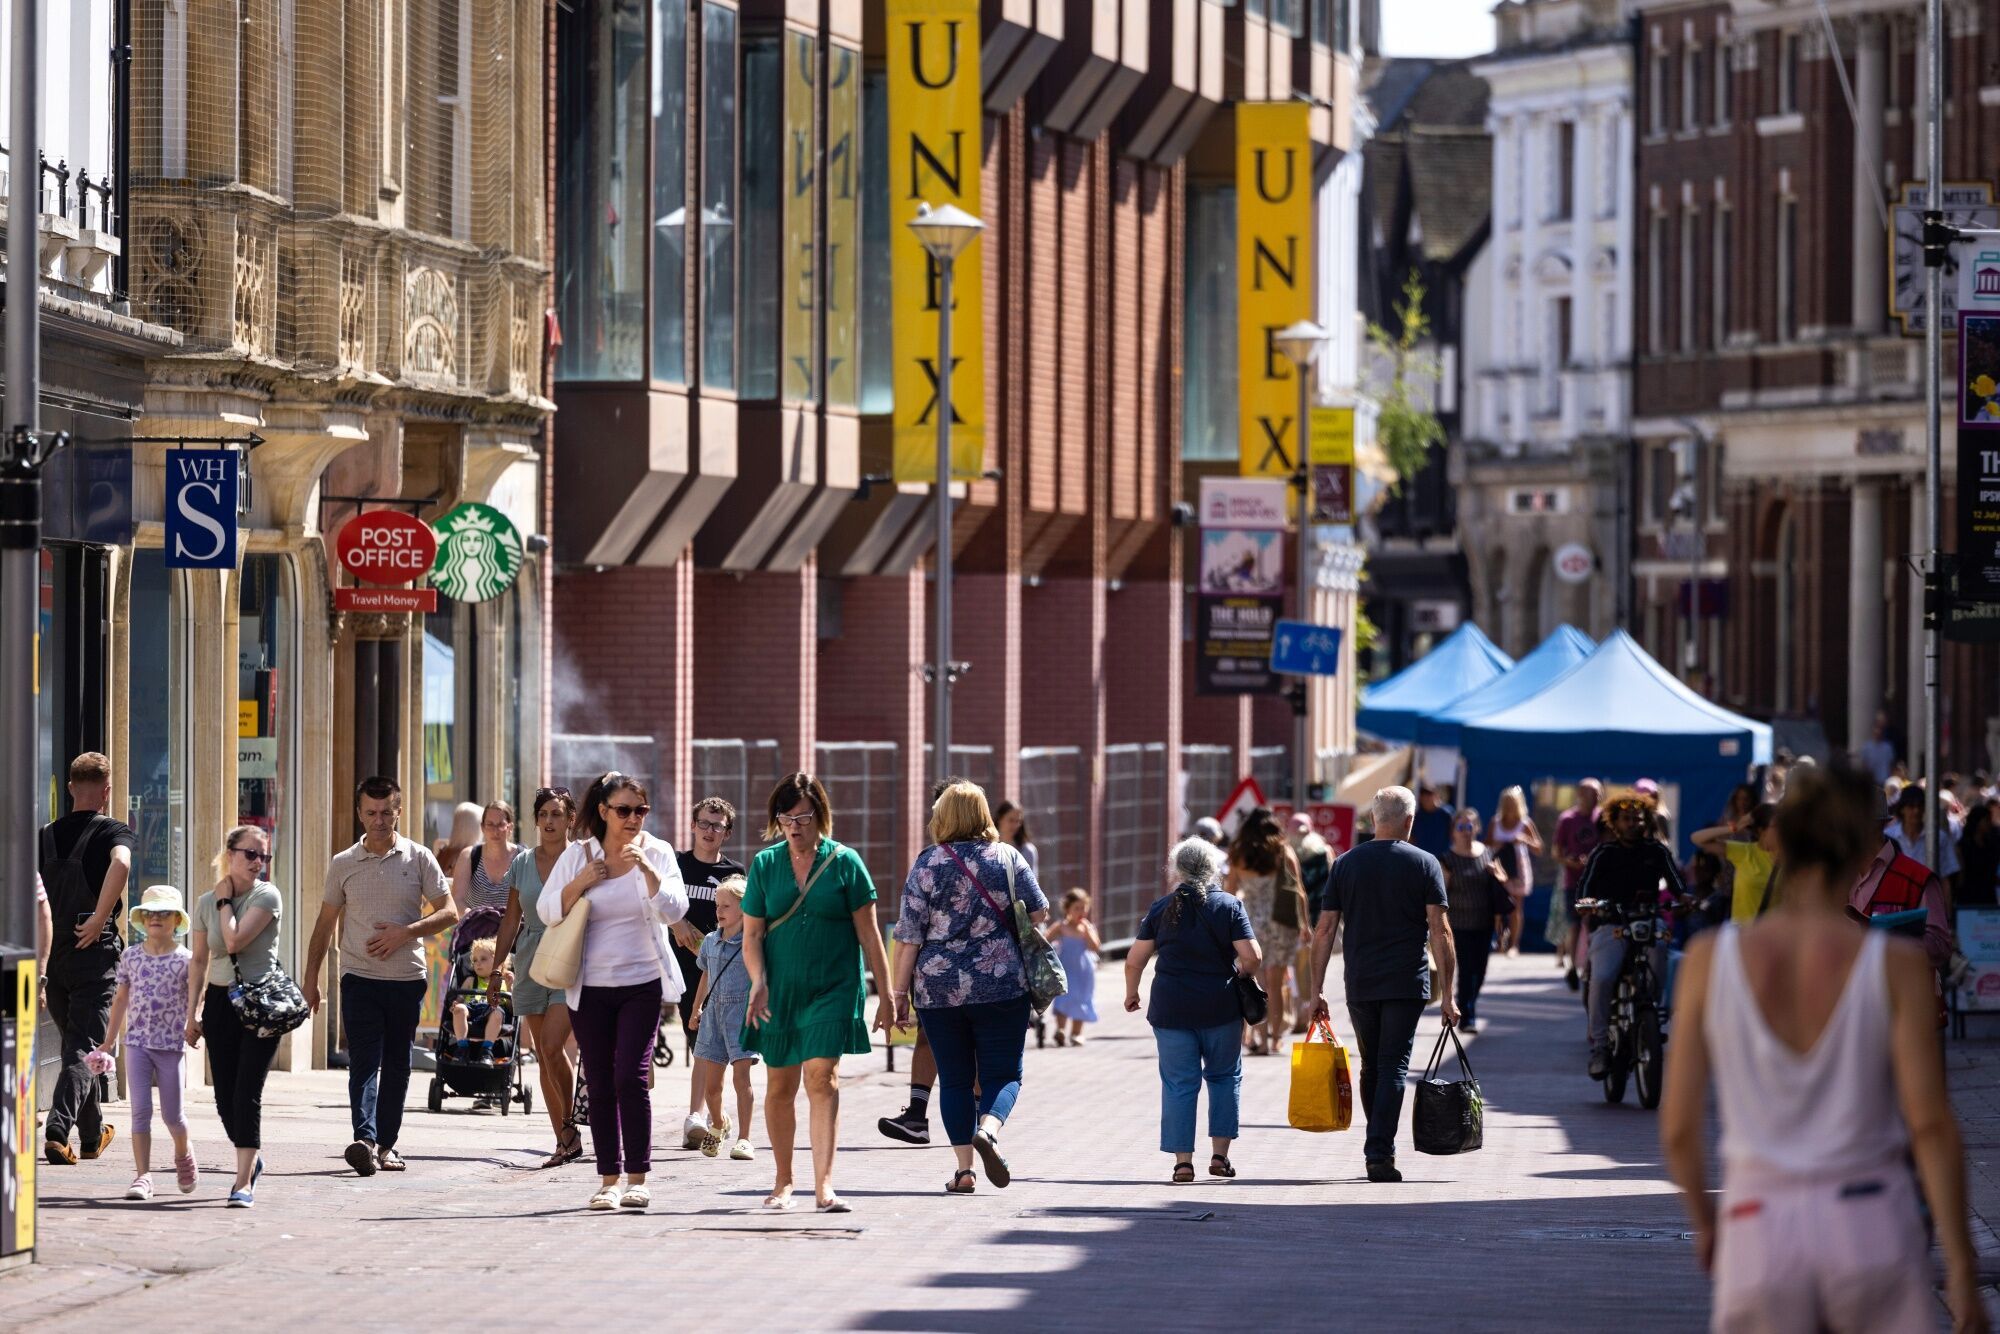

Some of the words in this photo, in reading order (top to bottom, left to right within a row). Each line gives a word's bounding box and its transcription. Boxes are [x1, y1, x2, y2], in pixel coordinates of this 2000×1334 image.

[905, 20, 966, 427] UNEX
[1251, 147, 1298, 473] UNEX
[177, 458, 228, 481] WH
[175, 481, 226, 560] S
[361, 527, 416, 547] POST
[347, 548, 423, 568] OFFICE
[351, 593, 381, 605] Travel
[384, 594, 419, 608] Money
